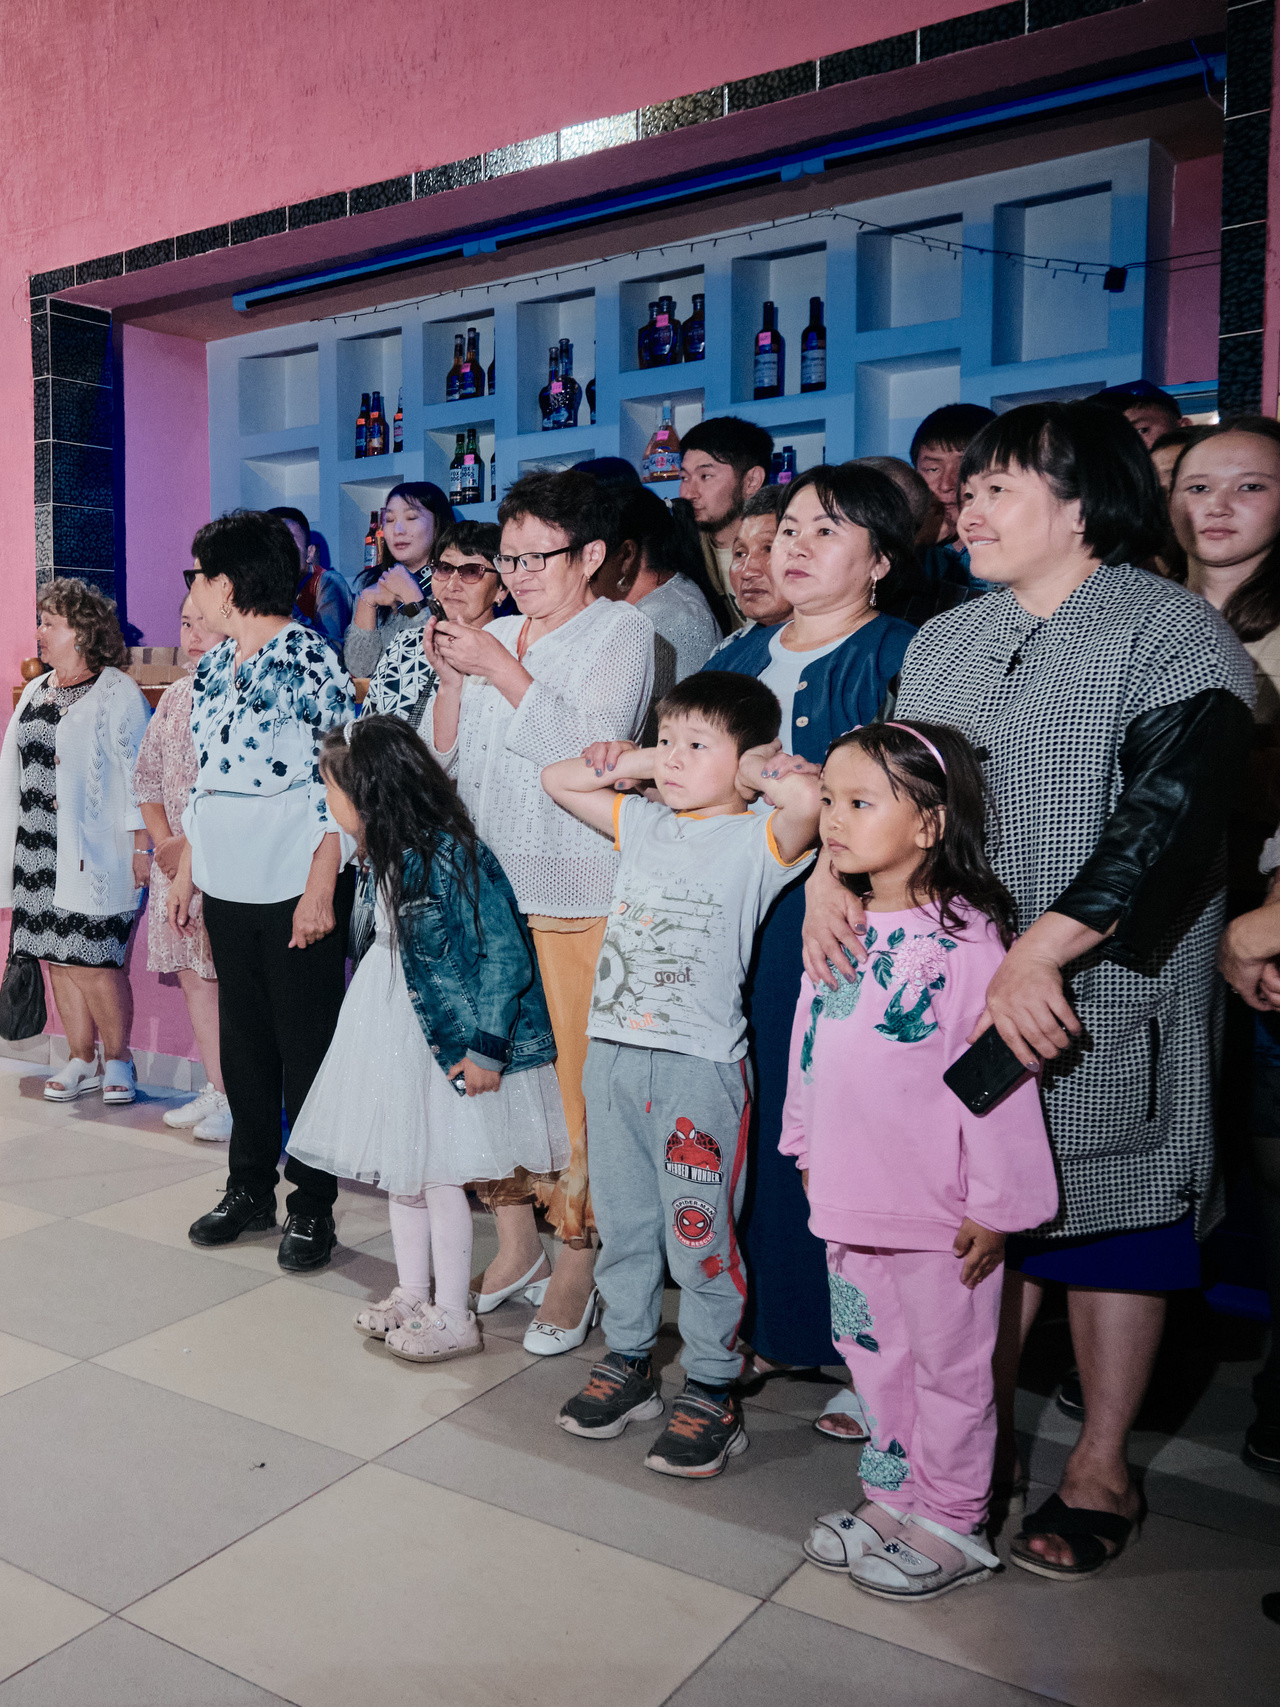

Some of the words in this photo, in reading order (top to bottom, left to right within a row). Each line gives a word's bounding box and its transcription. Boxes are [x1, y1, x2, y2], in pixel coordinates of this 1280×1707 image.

[654, 966, 691, 988] goal
[666, 1163, 689, 1178] WEBBED
[691, 1167, 720, 1182] WONDER
[675, 1200, 714, 1215] SPIDER-MAN
[691, 1232, 715, 1247] RESCUE
